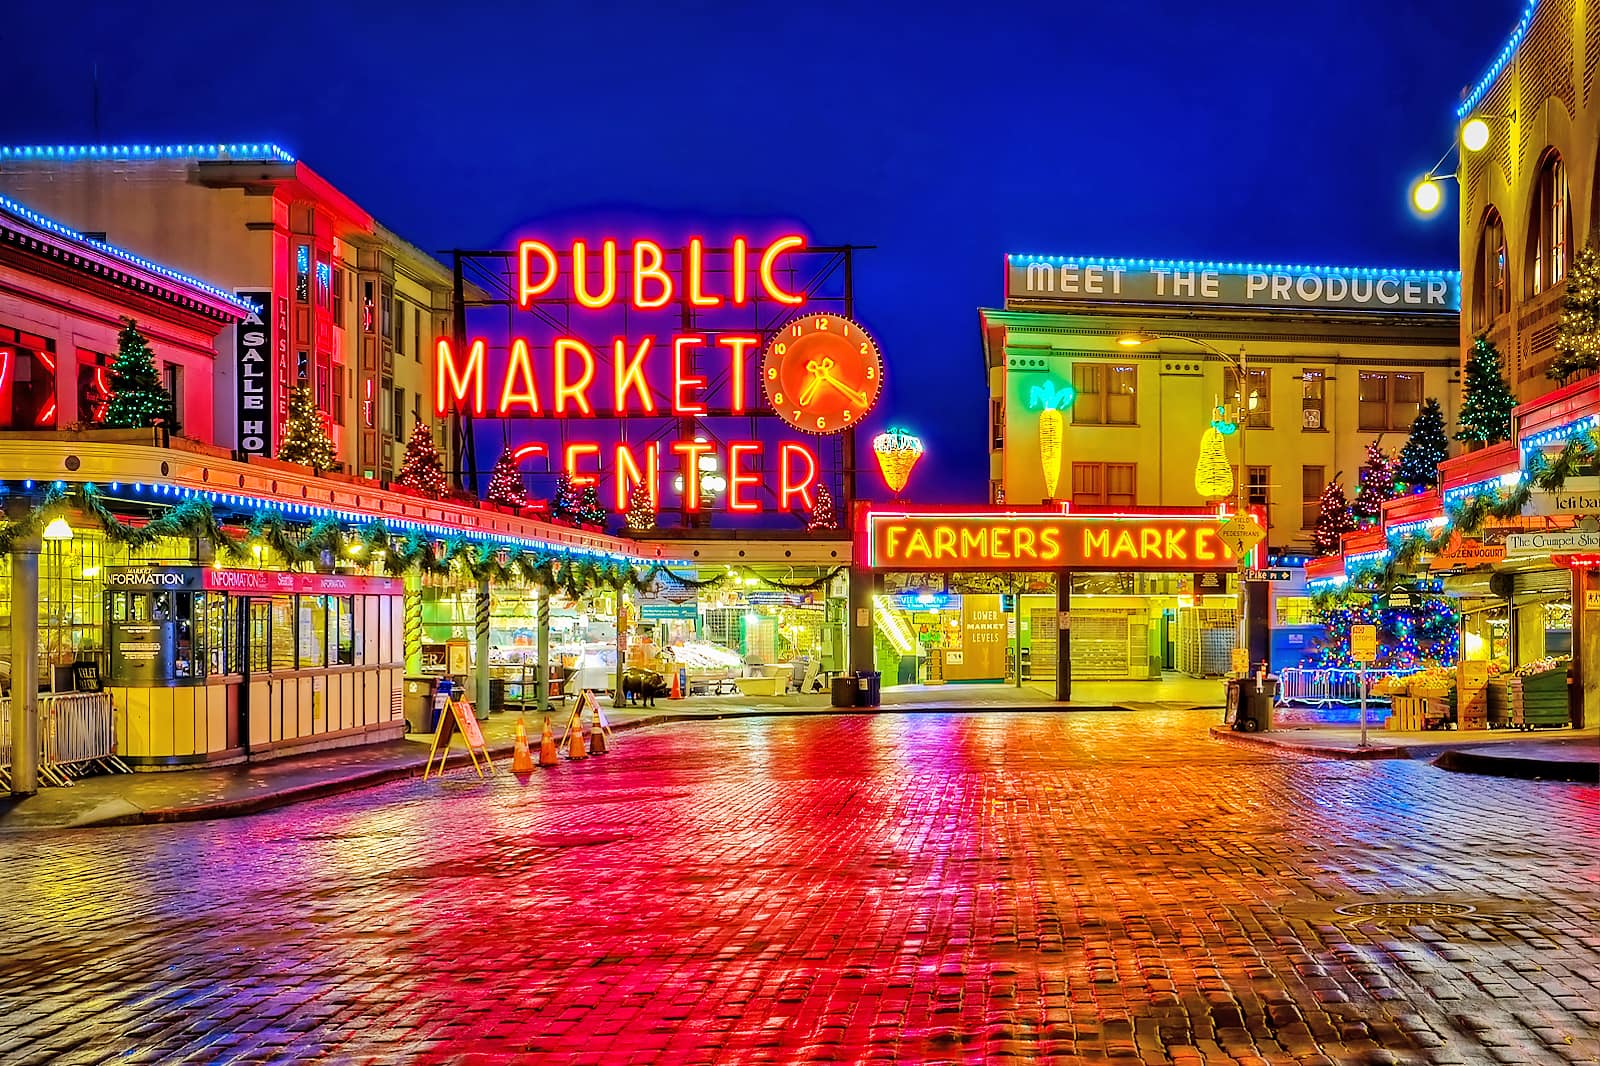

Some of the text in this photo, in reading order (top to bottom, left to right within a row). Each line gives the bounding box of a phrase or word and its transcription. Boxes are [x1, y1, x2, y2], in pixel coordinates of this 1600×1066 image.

[518, 236, 807, 309] PUBLIC
[1026, 262, 1448, 306] MEET THE PRODUCER
[815, 318, 828, 330] 12
[792, 325, 801, 336] 11
[844, 325, 848, 336] 1
[774, 343, 786, 354] 10
[860, 342, 868, 354] 2
[242, 332, 265, 409] SALLE
[767, 368, 777, 379] 9
[866, 367, 874, 379] 3
[435, 337, 761, 418] MARKET
[774, 393, 783, 404] 8
[793, 410, 801, 421] 7
[843, 410, 851, 421] 5
[816, 417, 825, 428] 6
[242, 421, 264, 456] HO
[886, 526, 1061, 560] FARMERS
[1510, 533, 1600, 548] The Crumpet Sho
[211, 572, 259, 588] INFORMATION
[1249, 571, 1267, 579] Pike
[973, 611, 998, 620] LOWER
[972, 633, 999, 642] LEVELS
